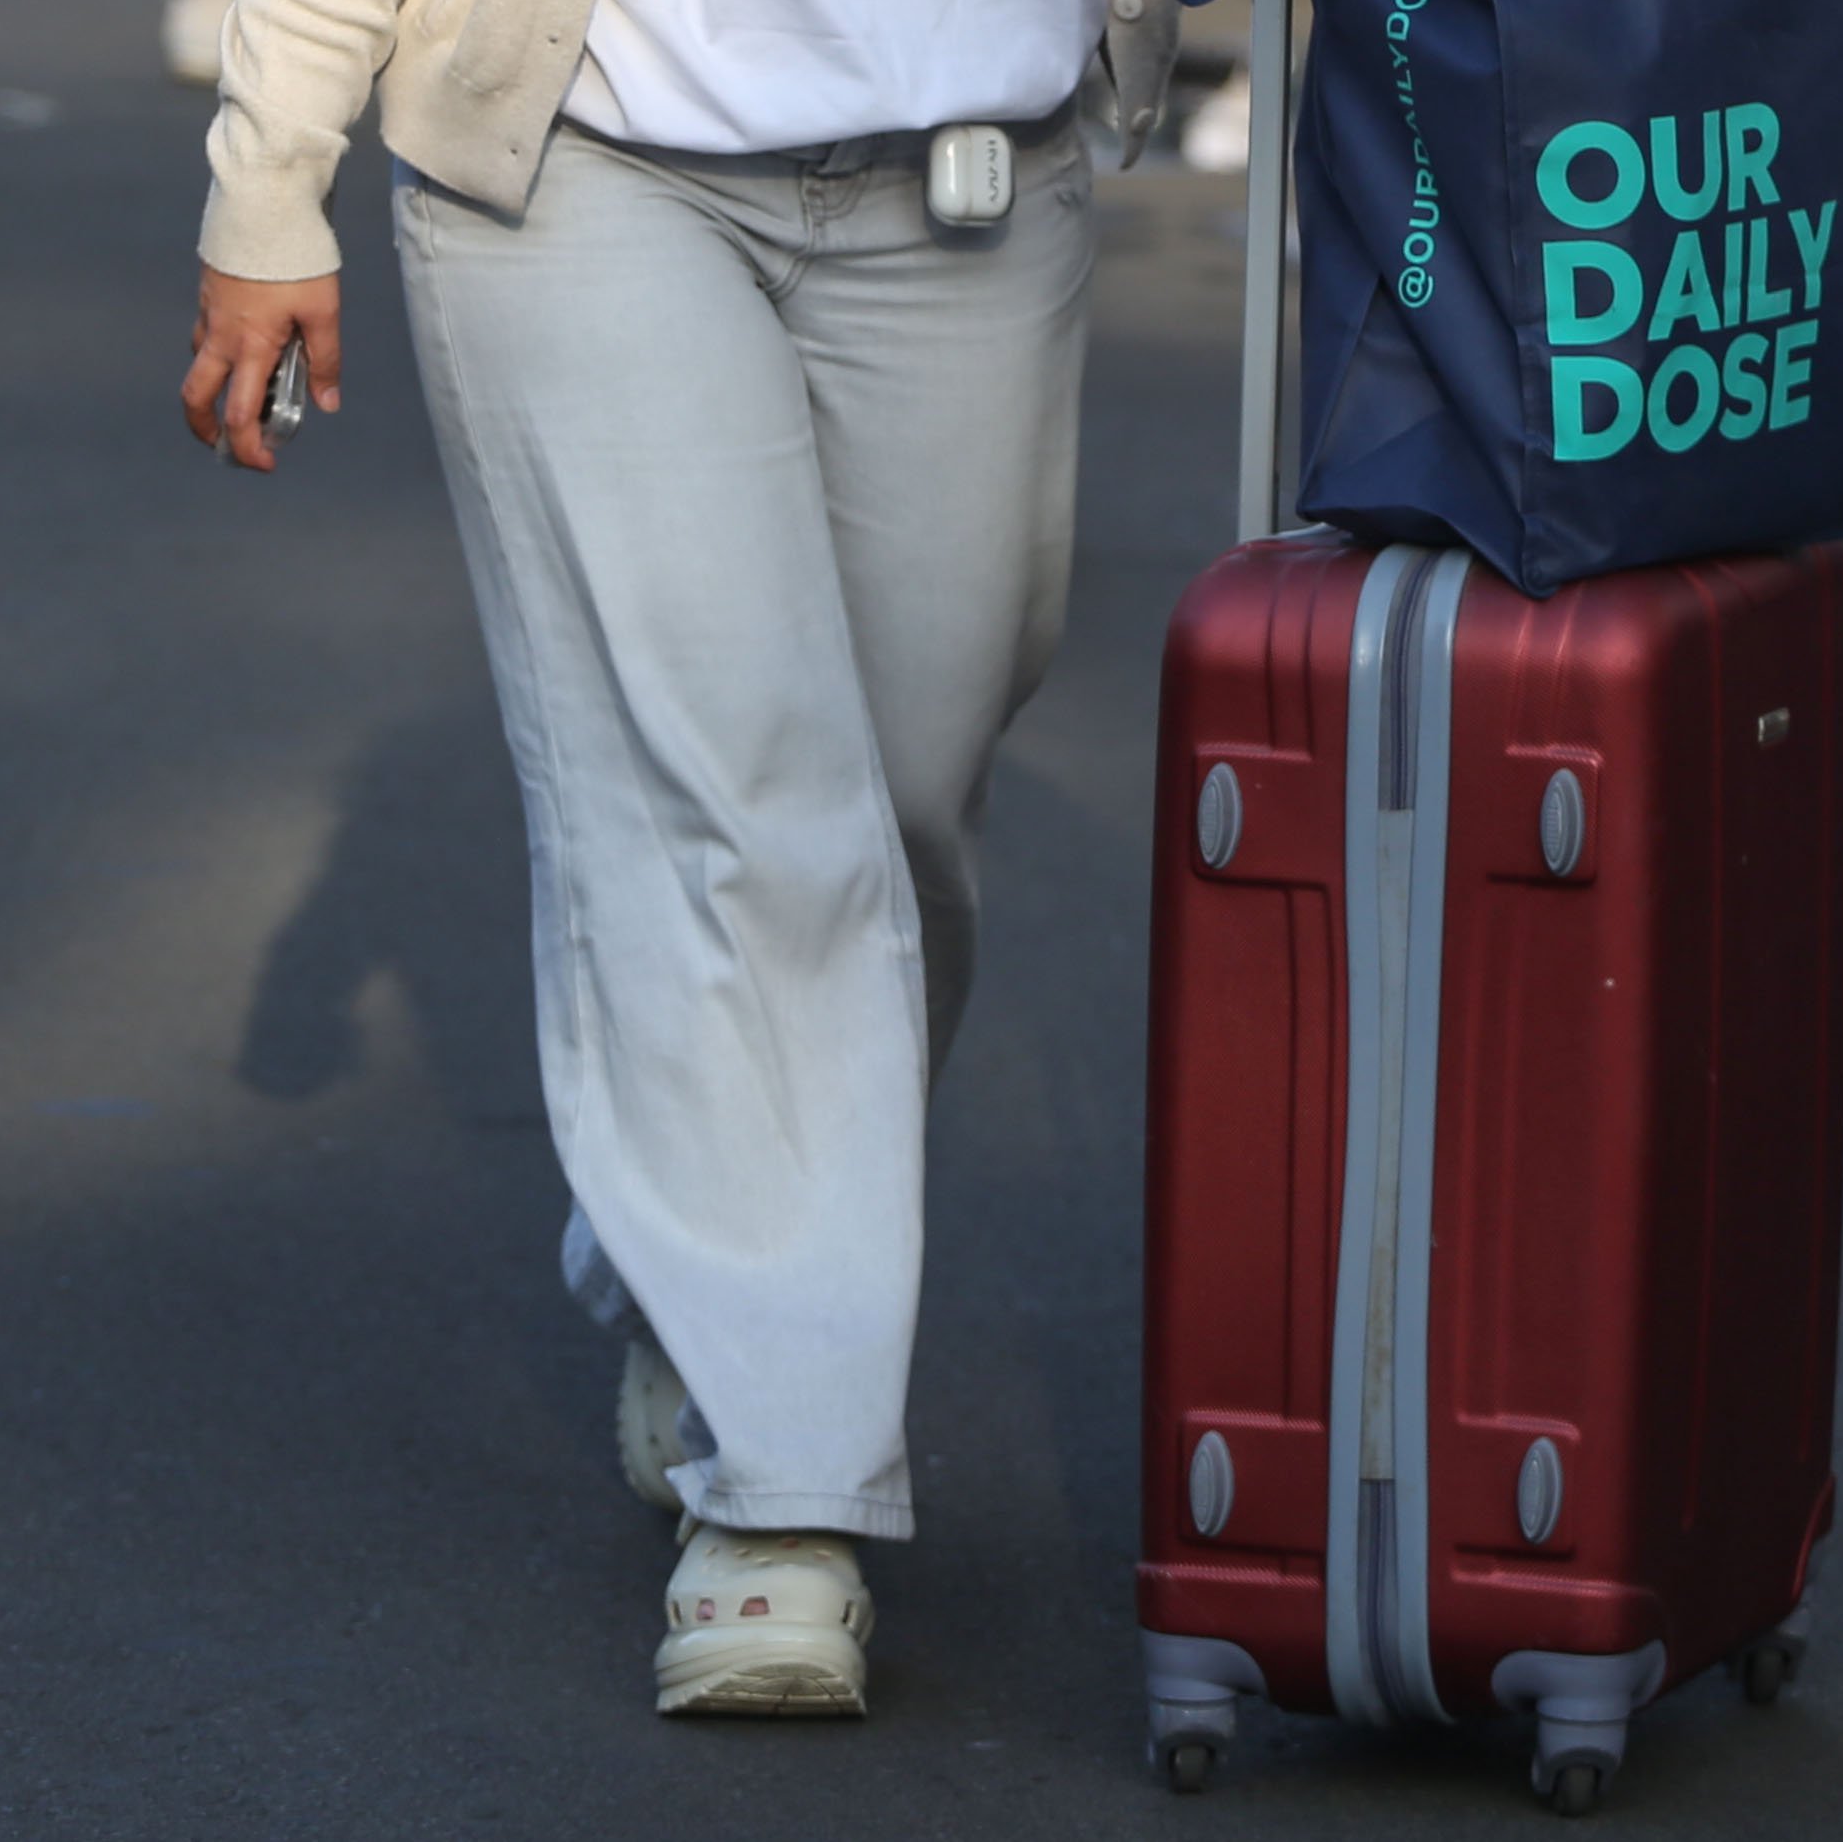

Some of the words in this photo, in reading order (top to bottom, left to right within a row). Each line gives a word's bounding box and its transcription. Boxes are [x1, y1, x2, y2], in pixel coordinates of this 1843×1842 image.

[1536, 102, 1780, 230] OUR
[1542, 200, 1837, 345] DAILY
[1550, 319, 1819, 461] DOSE
